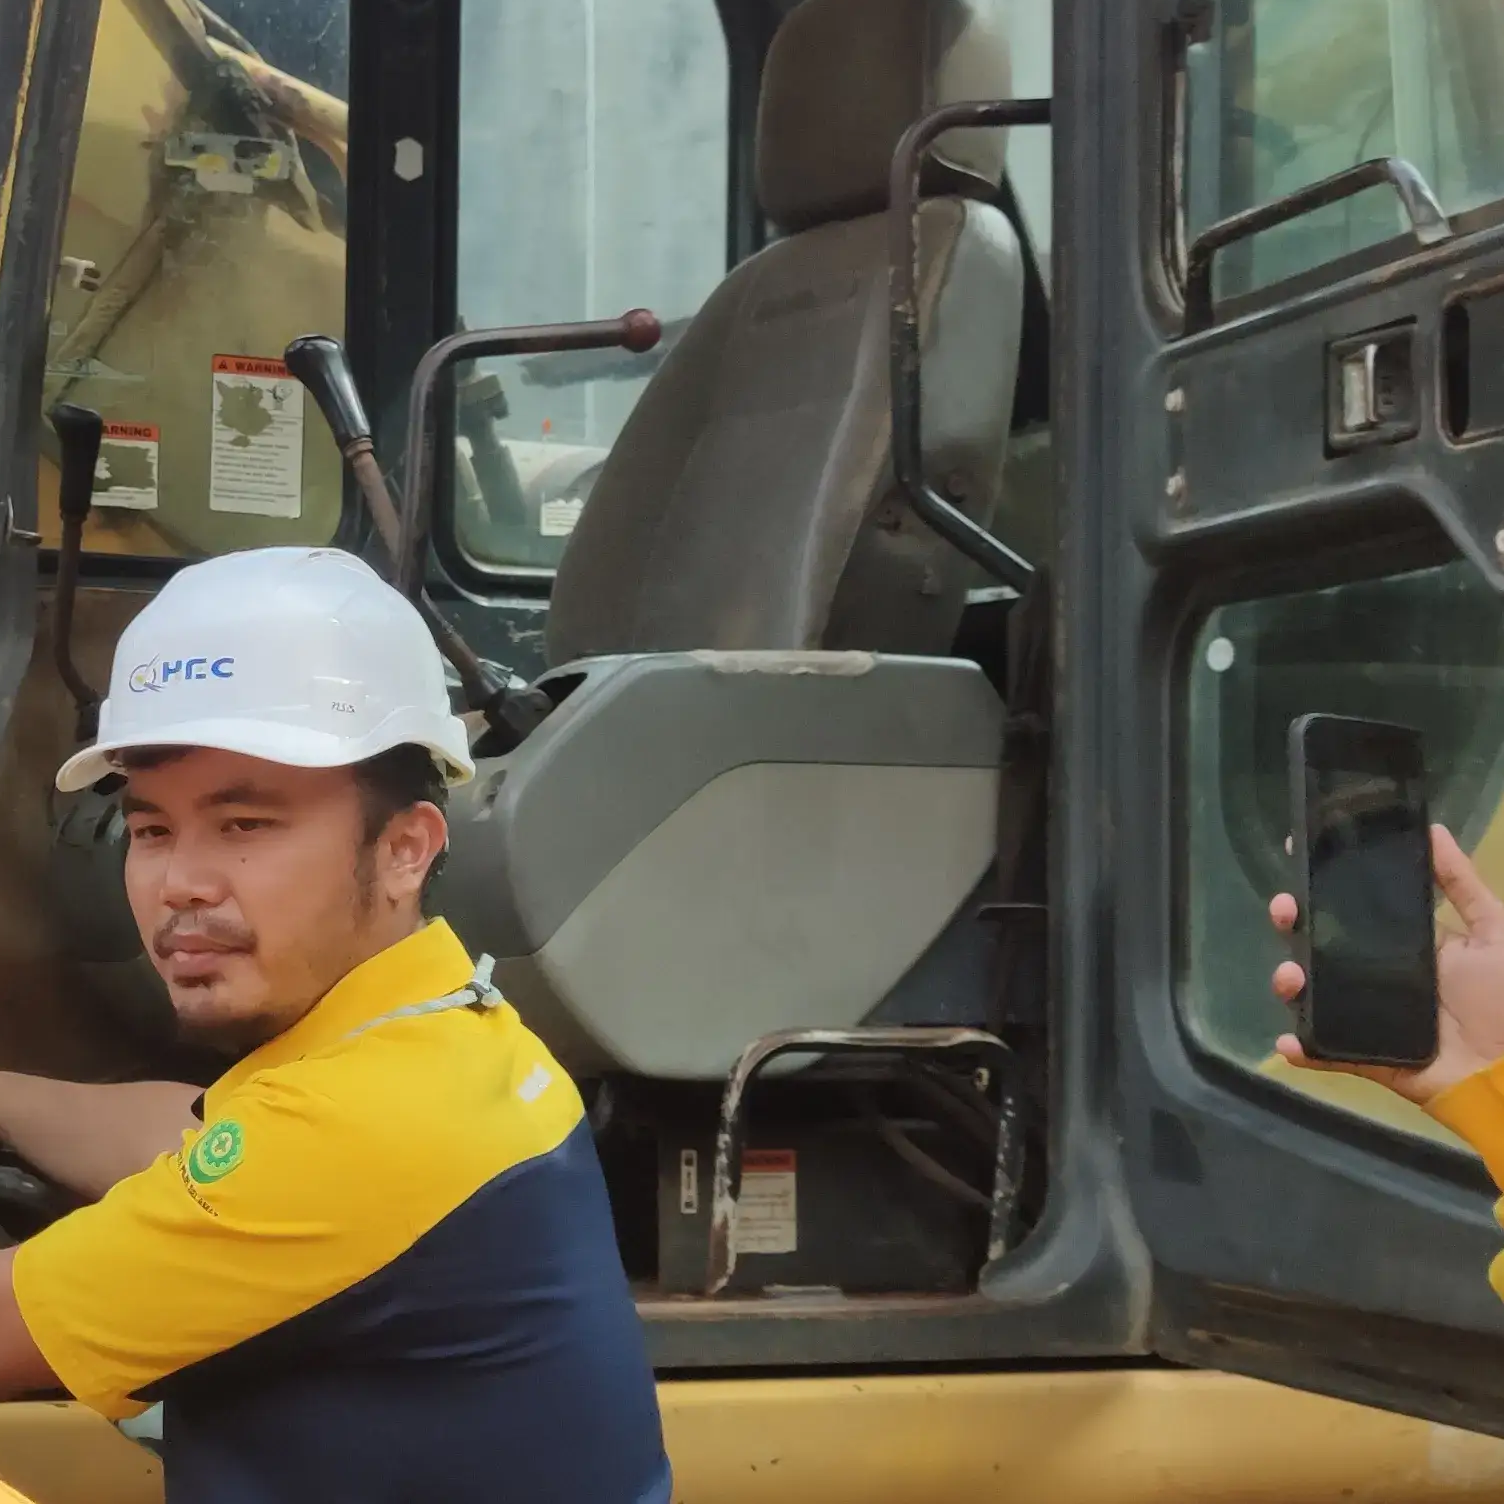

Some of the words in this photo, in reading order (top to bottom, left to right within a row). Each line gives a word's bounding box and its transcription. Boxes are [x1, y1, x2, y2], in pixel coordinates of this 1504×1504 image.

[234, 361, 288, 377] WARNIN
[102, 423, 152, 439] ARNING
[161, 656, 235, 683] HEC
